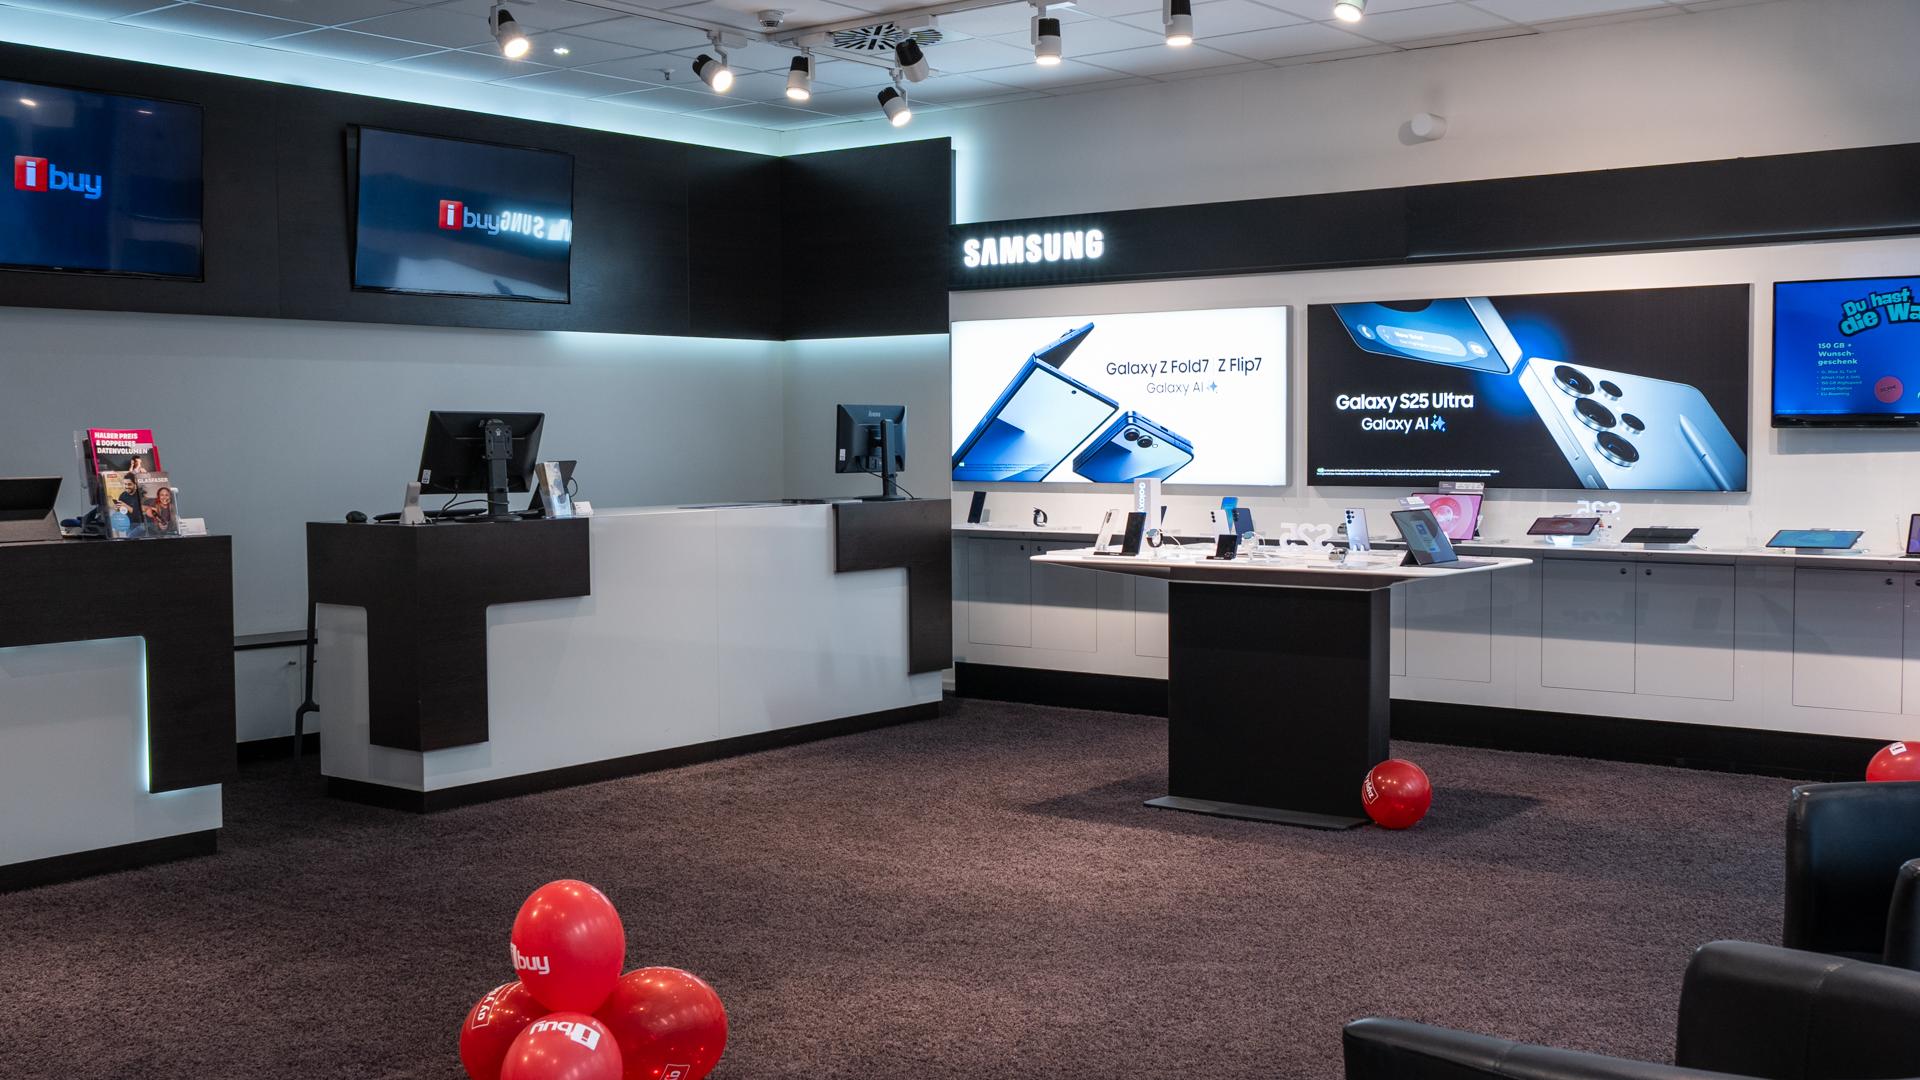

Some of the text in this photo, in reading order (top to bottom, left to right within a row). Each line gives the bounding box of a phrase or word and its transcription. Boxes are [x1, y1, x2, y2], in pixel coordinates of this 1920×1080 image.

[964, 229, 1104, 268] SAMSUNG
[1843, 288, 1910, 317] Du hast
[1841, 312, 1879, 335] die
[1106, 357, 1262, 377] Galaxy Z Fold7 Z Flip7
[1146, 381, 1204, 396] Galaxy AI
[1336, 392, 1474, 413] Galaxy S25 Ultra
[1361, 417, 1429, 434] Galaxy AI
[119, 432, 138, 440] PREIS
[97, 447, 148, 455] DATENVOLUMEN
[512, 943, 550, 975] buy
